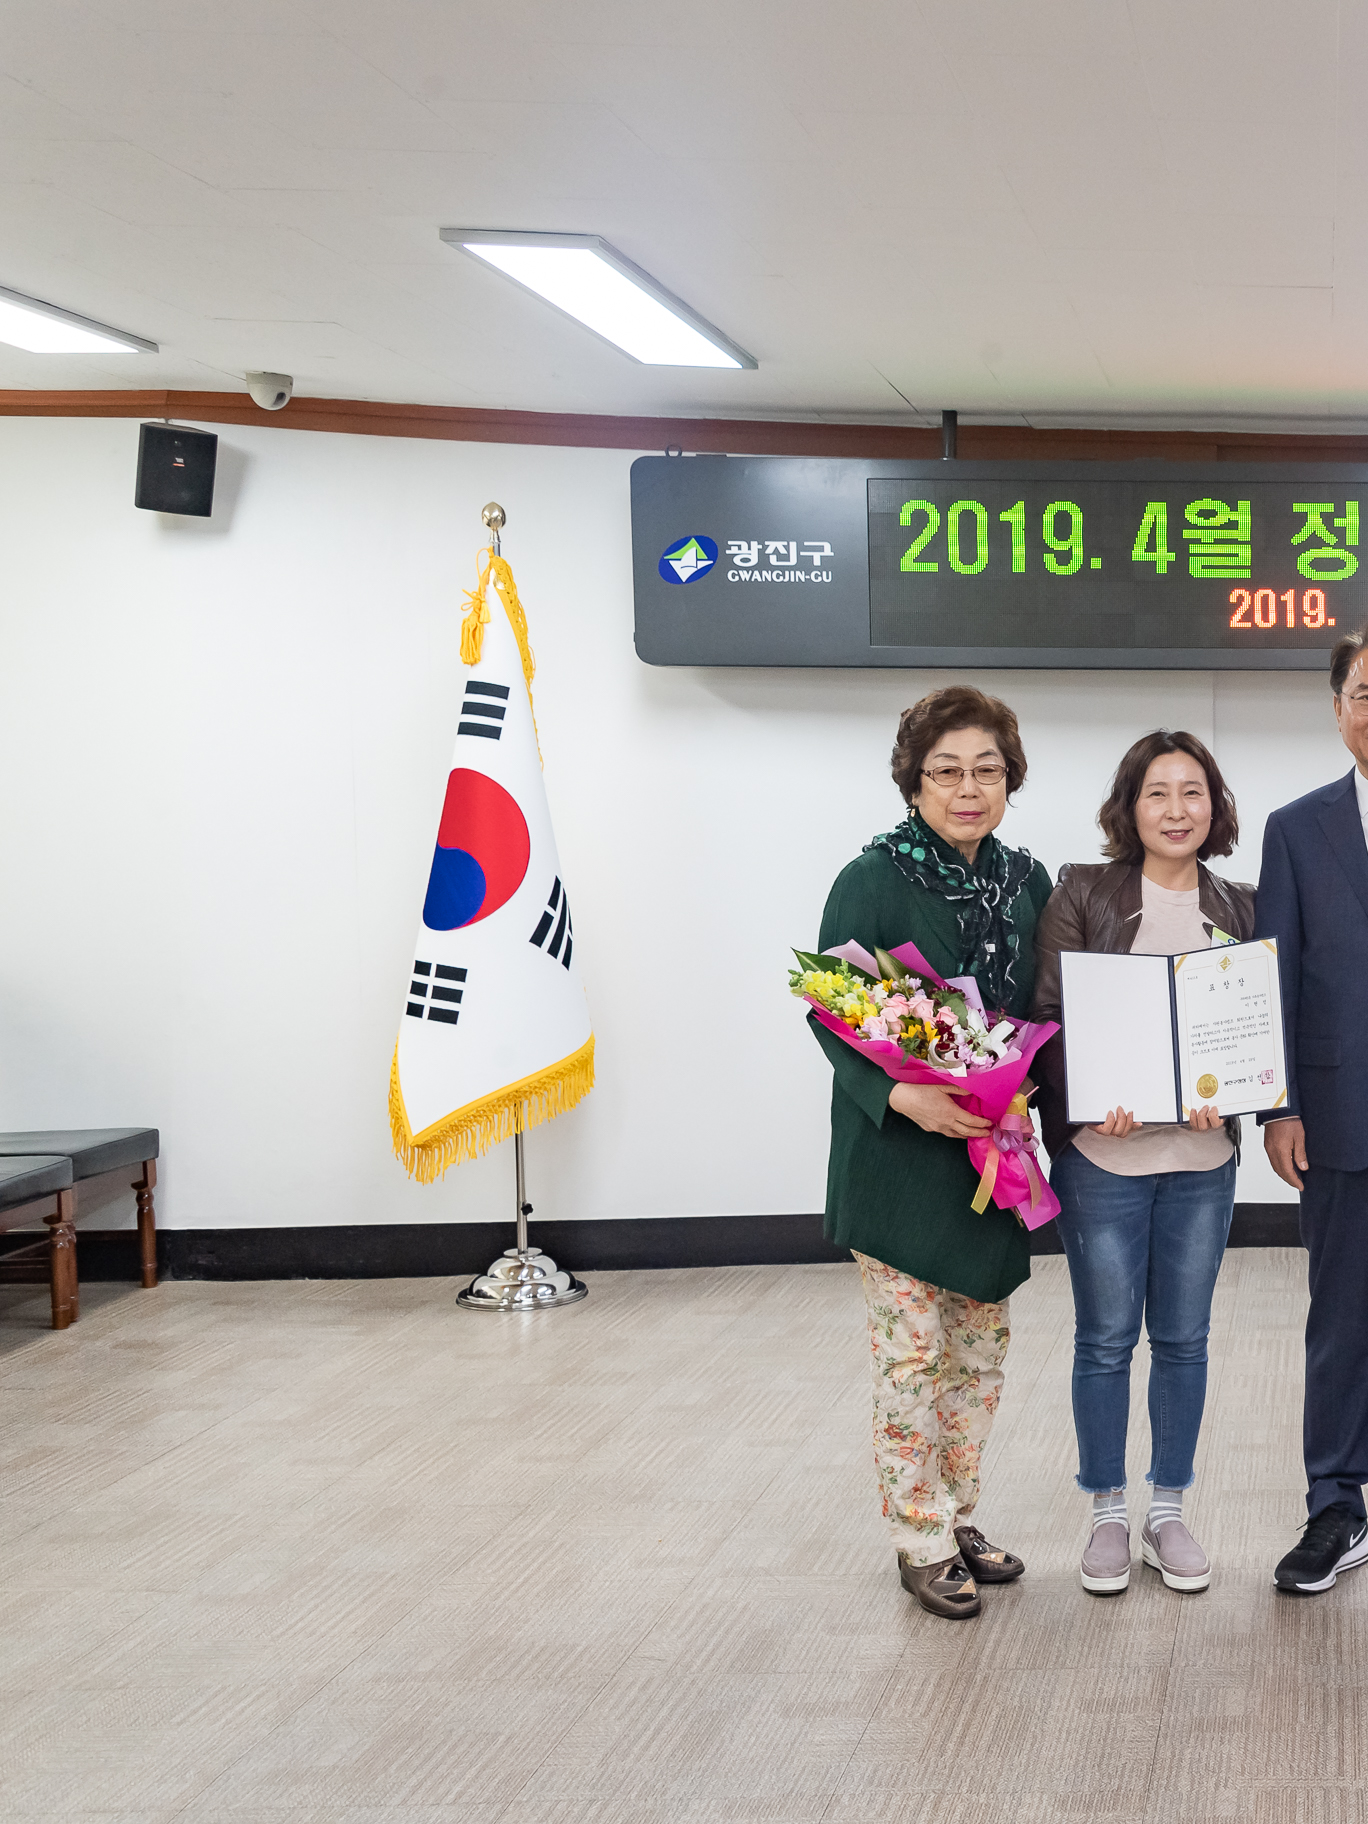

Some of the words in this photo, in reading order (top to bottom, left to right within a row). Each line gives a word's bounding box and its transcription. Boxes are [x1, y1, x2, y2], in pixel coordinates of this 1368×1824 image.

[725, 539, 835, 567] 광진구
[900, 499, 1101, 576] 2019.
[1131, 498, 1252, 579] 4월
[727, 569, 833, 583] GWANGJIN-GU
[1229, 588, 1336, 628] 2019.
